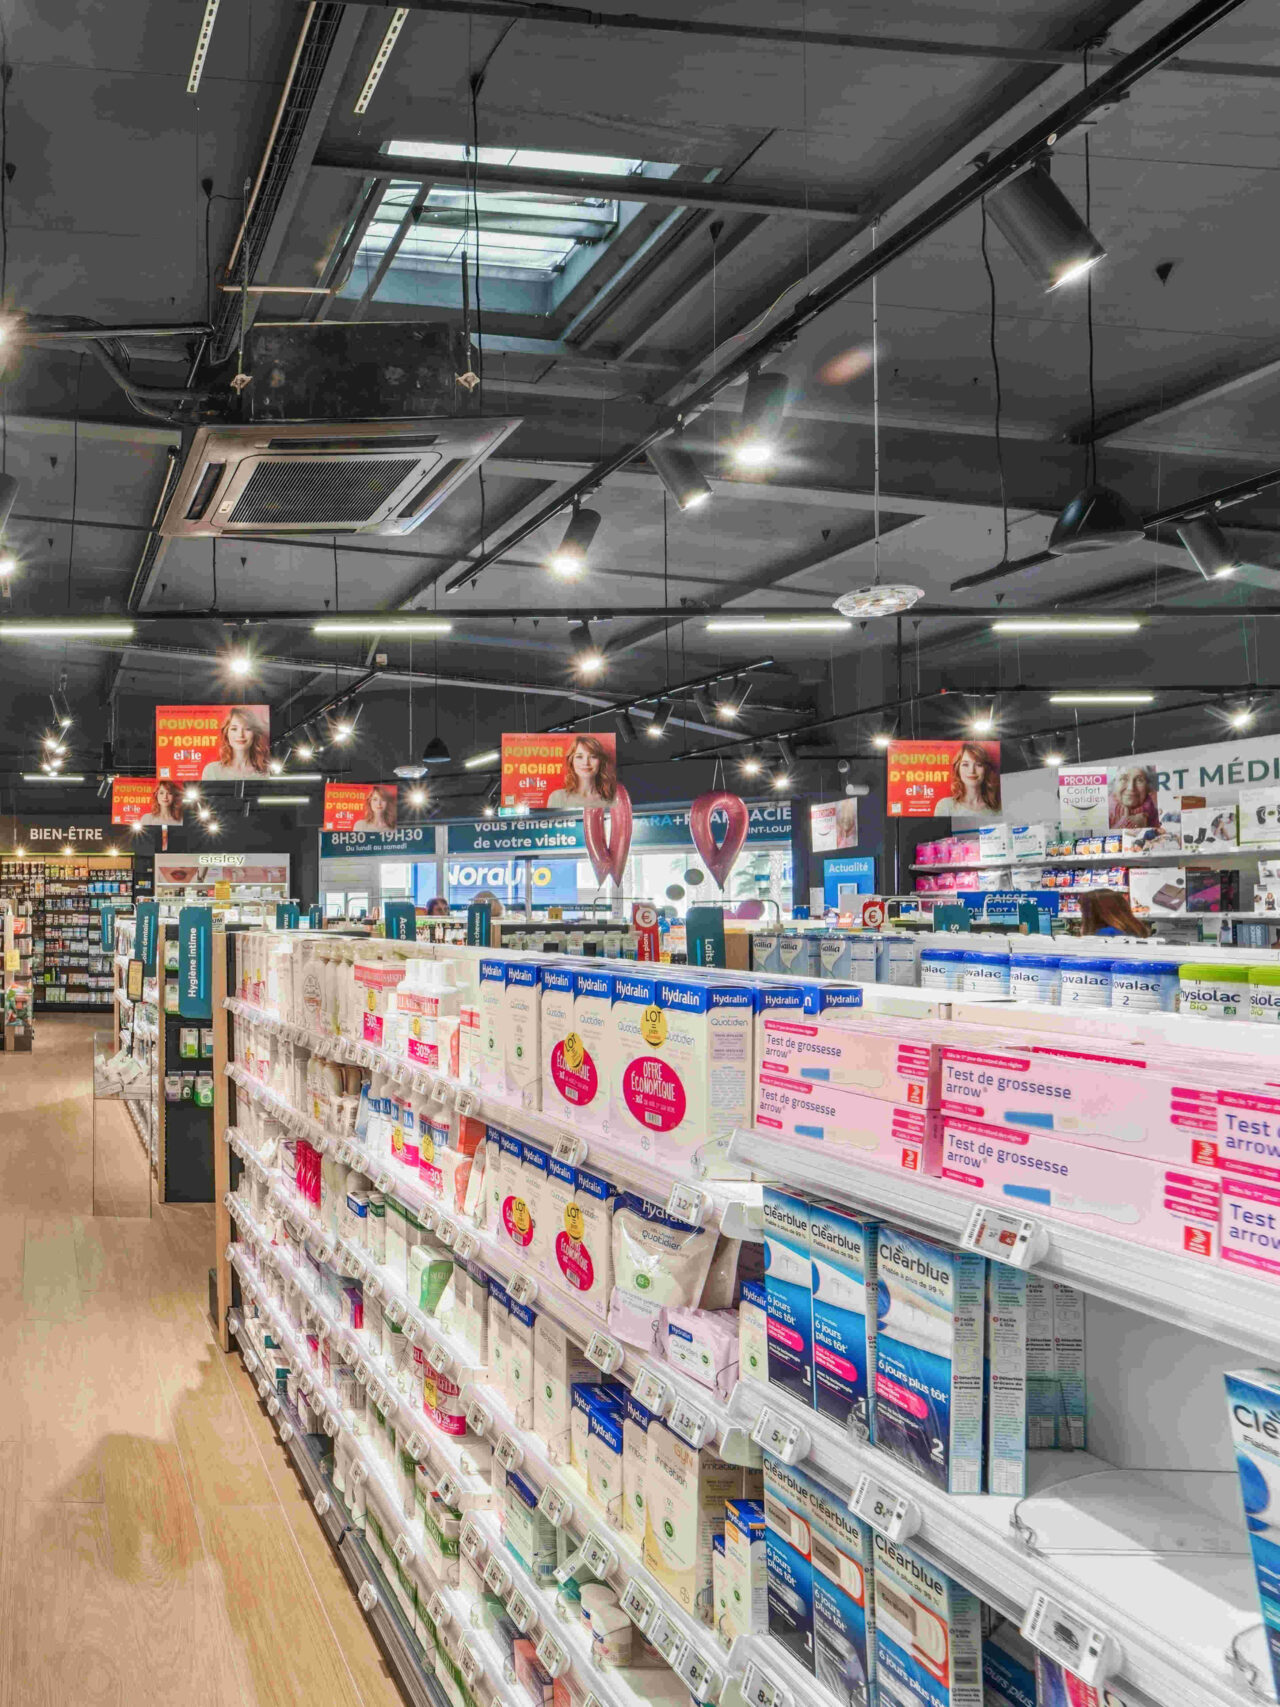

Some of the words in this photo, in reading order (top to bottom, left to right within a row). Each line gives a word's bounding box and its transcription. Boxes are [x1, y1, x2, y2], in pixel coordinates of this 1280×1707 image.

[158, 718, 218, 730] POUVOIR
[158, 735, 218, 747] D'ACHAT
[505, 745, 562, 758] POUVOIR
[890, 754, 950, 765] POUVOIR
[504, 763, 562, 775] D'ACHAT
[890, 771, 949, 782] D'ACHAT
[114, 785, 152, 794] POUVOIR
[1064, 776, 1102, 785] PROMO
[327, 791, 365, 800] POUVOIR
[1066, 785, 1101, 795] Confort
[1062, 796, 1106, 805] quotidien
[29, 826, 104, 841] BIEN-ÊTRE
[331, 832, 366, 845] 8H30
[379, 828, 423, 842] 19H30
[474, 838, 491, 849] de
[494, 837, 532, 848] votre
[536, 833, 577, 847] visite
[355, 843, 372, 852] lundi
[383, 843, 408, 851] samedi
[199, 853, 246, 866] sisley
[828, 862, 869, 873] Actualité
[187, 927, 197, 957] intime
[187, 959, 199, 998] Hygiène
[508, 967, 532, 983] Hydralin
[544, 971, 569, 988] Hydralin
[577, 976, 608, 994] Hydralin
[615, 980, 649, 999] Hydralin
[662, 985, 700, 1006] Hydralin
[712, 993, 748, 1004] Hydralin
[764, 995, 800, 1006] Hydralin
[825, 993, 860, 1005] Hydralin
[1122, 995, 1131, 1006] 2
[645, 1010, 662, 1024] LOT
[710, 1017, 749, 1028] Quotidien
[766, 1034, 784, 1046] Test
[786, 1037, 796, 1048] de
[797, 1041, 842, 1057] grossesse
[642, 1060, 663, 1081] OFFRE
[946, 1065, 975, 1082] Test
[978, 1072, 994, 1086] de
[997, 1076, 1072, 1100] grossesse
[761, 1088, 778, 1102] Test
[780, 1093, 790, 1104] de
[791, 1096, 836, 1117] grossesse
[1225, 1113, 1271, 1138] Test
[523, 1146, 544, 1167] Hydralin
[948, 1134, 975, 1153] Test
[978, 1143, 994, 1157] de
[996, 1148, 1069, 1177] grossesse
[549, 1159, 571, 1180] Hydralin
[578, 1173, 603, 1195] Hydralin
[763, 1204, 807, 1231] Clearblue
[1229, 1203, 1277, 1230] Test
[811, 1223, 861, 1254] Clearblue
[879, 1243, 951, 1285] Clearblue
[882, 1264, 900, 1276] Fiable
[905, 1276, 918, 1288] plus
[919, 1281, 927, 1289] de
[928, 1284, 937, 1293] 99
[767, 1293, 772, 1303] 6
[773, 1295, 792, 1313] jours
[767, 1306, 783, 1322] plus
[815, 1318, 820, 1328] 6
[821, 1321, 842, 1341] jours
[815, 1331, 832, 1348] plus
[878, 1359, 885, 1369] 6
[884, 1361, 908, 1384] jours
[908, 1375, 929, 1396] plus
[930, 1387, 946, 1404] tôt
[591, 1417, 618, 1448] Hydralin
[931, 1437, 945, 1456] 2
[763, 1458, 808, 1499] Clearblue
[808, 1493, 859, 1538] Clearblue
[875, 1535, 944, 1596] Clearblue
[878, 1649, 886, 1661] 6
[885, 1653, 908, 1681] jours
[909, 1673, 931, 1700] plus
